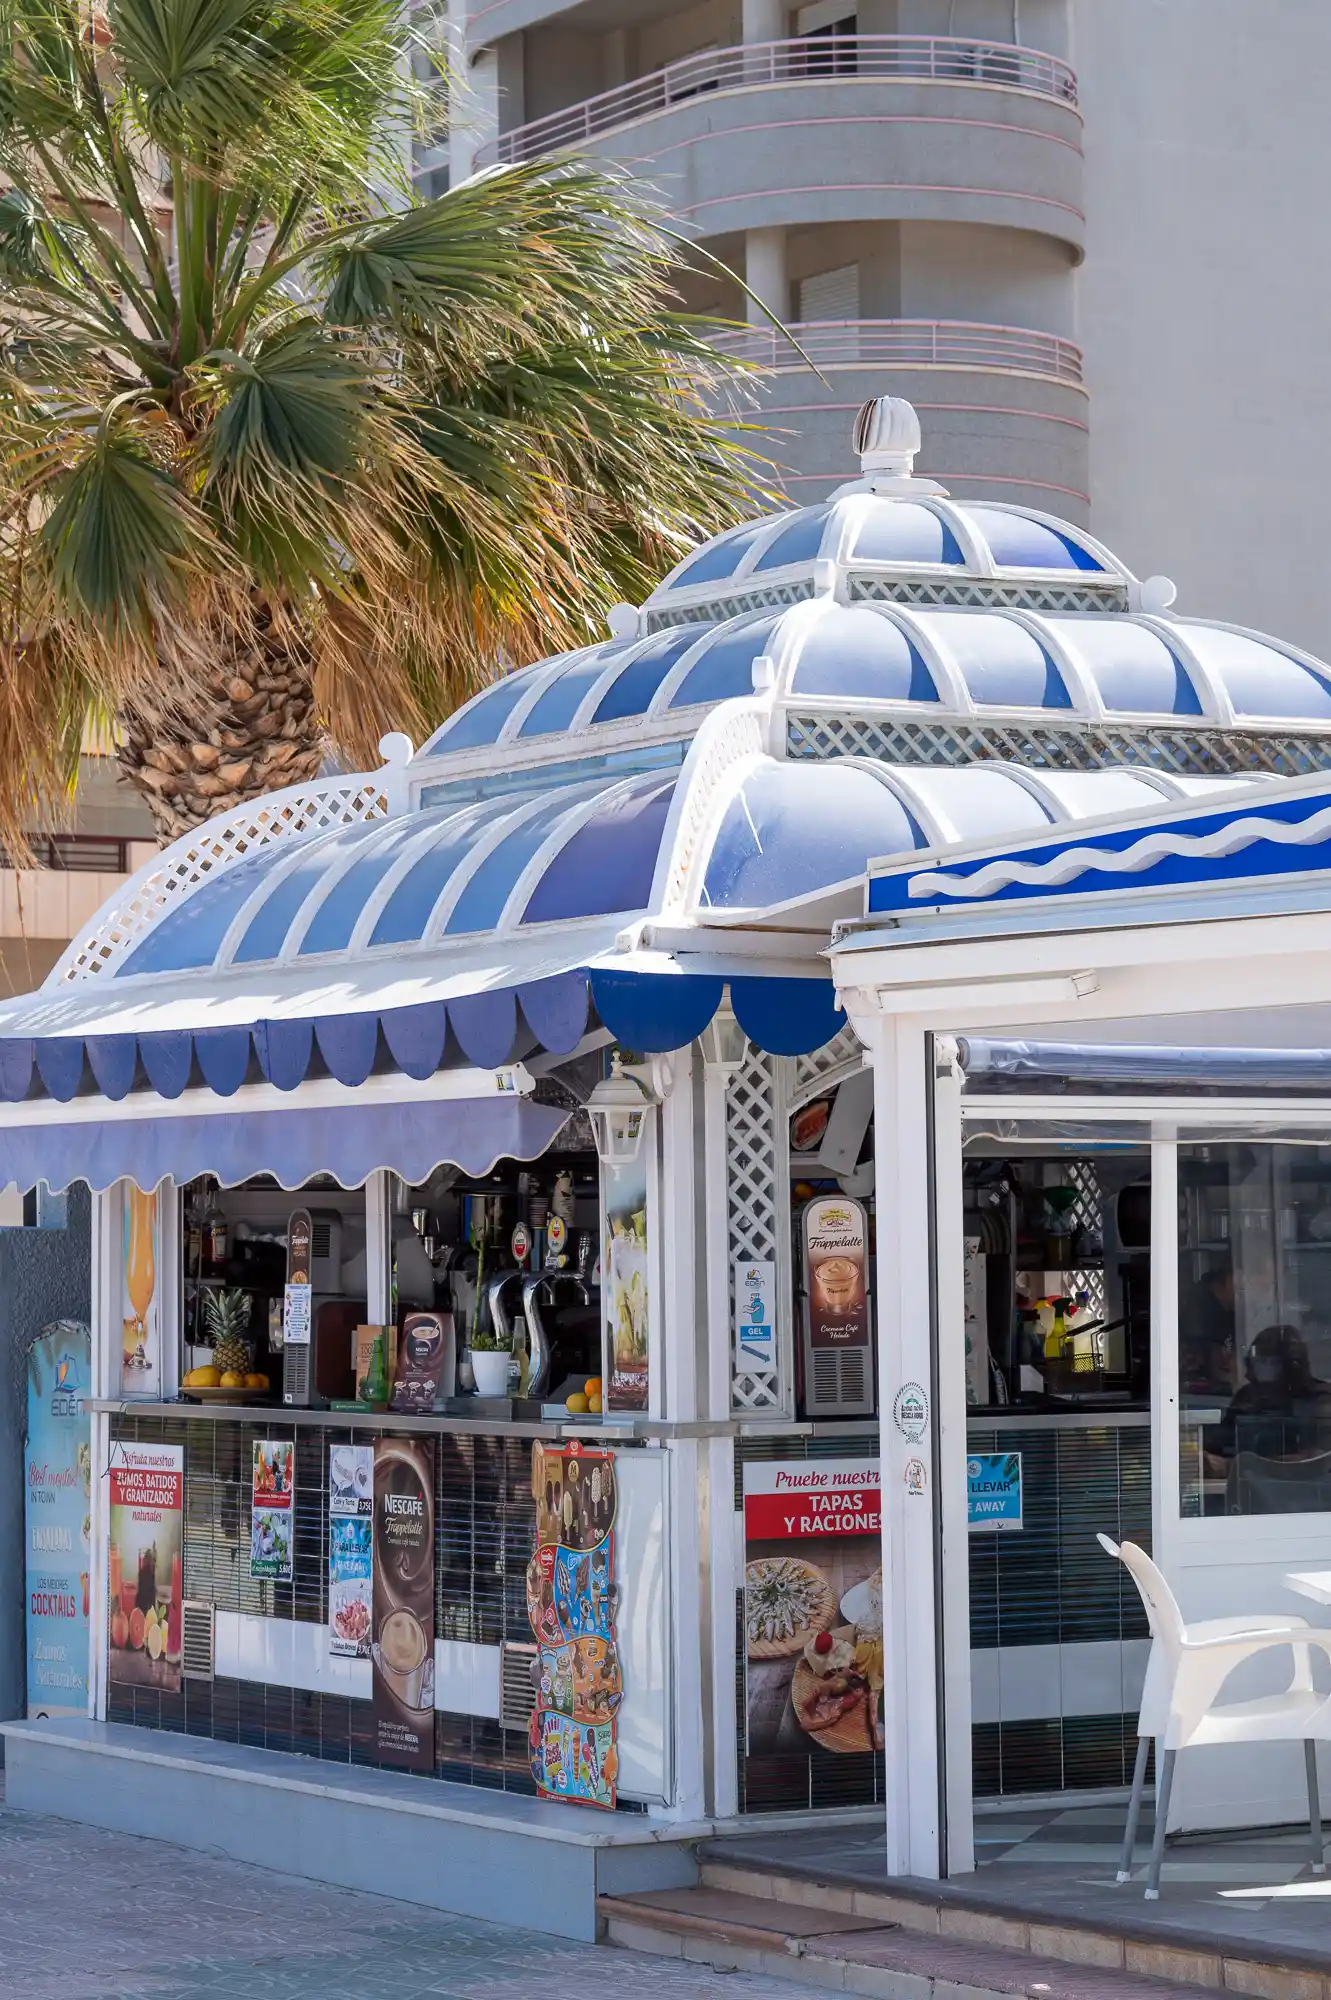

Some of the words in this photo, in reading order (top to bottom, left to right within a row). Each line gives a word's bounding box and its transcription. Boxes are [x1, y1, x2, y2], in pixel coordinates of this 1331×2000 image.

[748, 1327, 763, 1335] GEL
[28, 1460, 47, 1487] Best
[116, 1472, 145, 1489] ZUMOS,
[145, 1474, 177, 1490] BATIDOS
[775, 1471, 828, 1488] Pruebe
[831, 1469, 881, 1486] nuestr
[971, 1482, 1010, 1493] LLEVAR
[120, 1488, 126, 1501] Y
[126, 1488, 174, 1505] GRANIZADOS
[808, 1493, 863, 1512] TAPAS
[131, 1508, 162, 1523] naturales
[975, 1501, 1006, 1513] AWAY
[783, 1516, 796, 1533] Y
[37, 1577, 48, 1588] LOS
[31, 1593, 76, 1618] COCKTAILS
